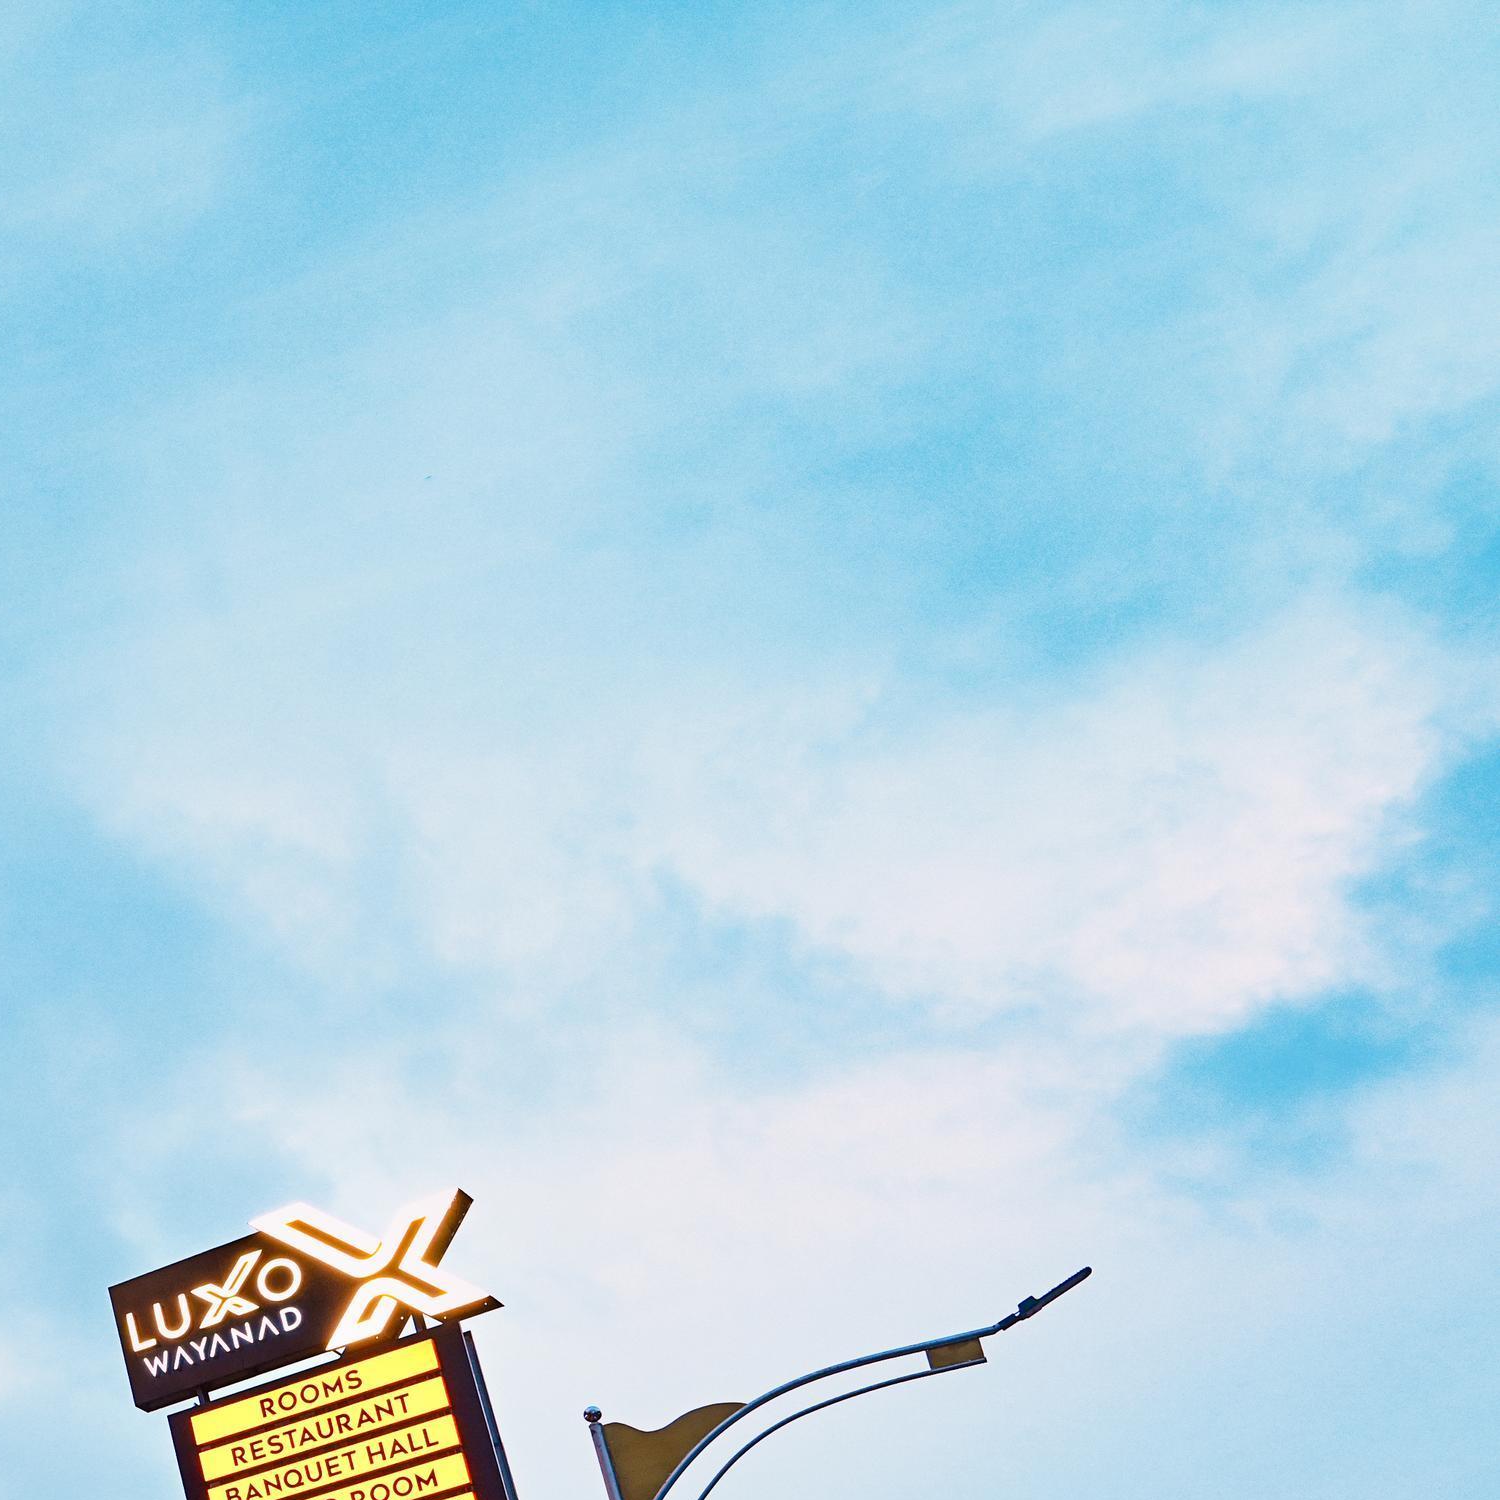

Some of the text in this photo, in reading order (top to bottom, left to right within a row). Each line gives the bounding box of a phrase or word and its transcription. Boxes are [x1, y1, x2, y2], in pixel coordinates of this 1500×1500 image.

[126, 1249, 303, 1352] LUXO
[143, 1306, 303, 1377] WAYANAD
[259, 1369, 363, 1418] ROOMS
[231, 1393, 410, 1467] RESTAURANT
[367, 1428, 439, 1465] HALL
